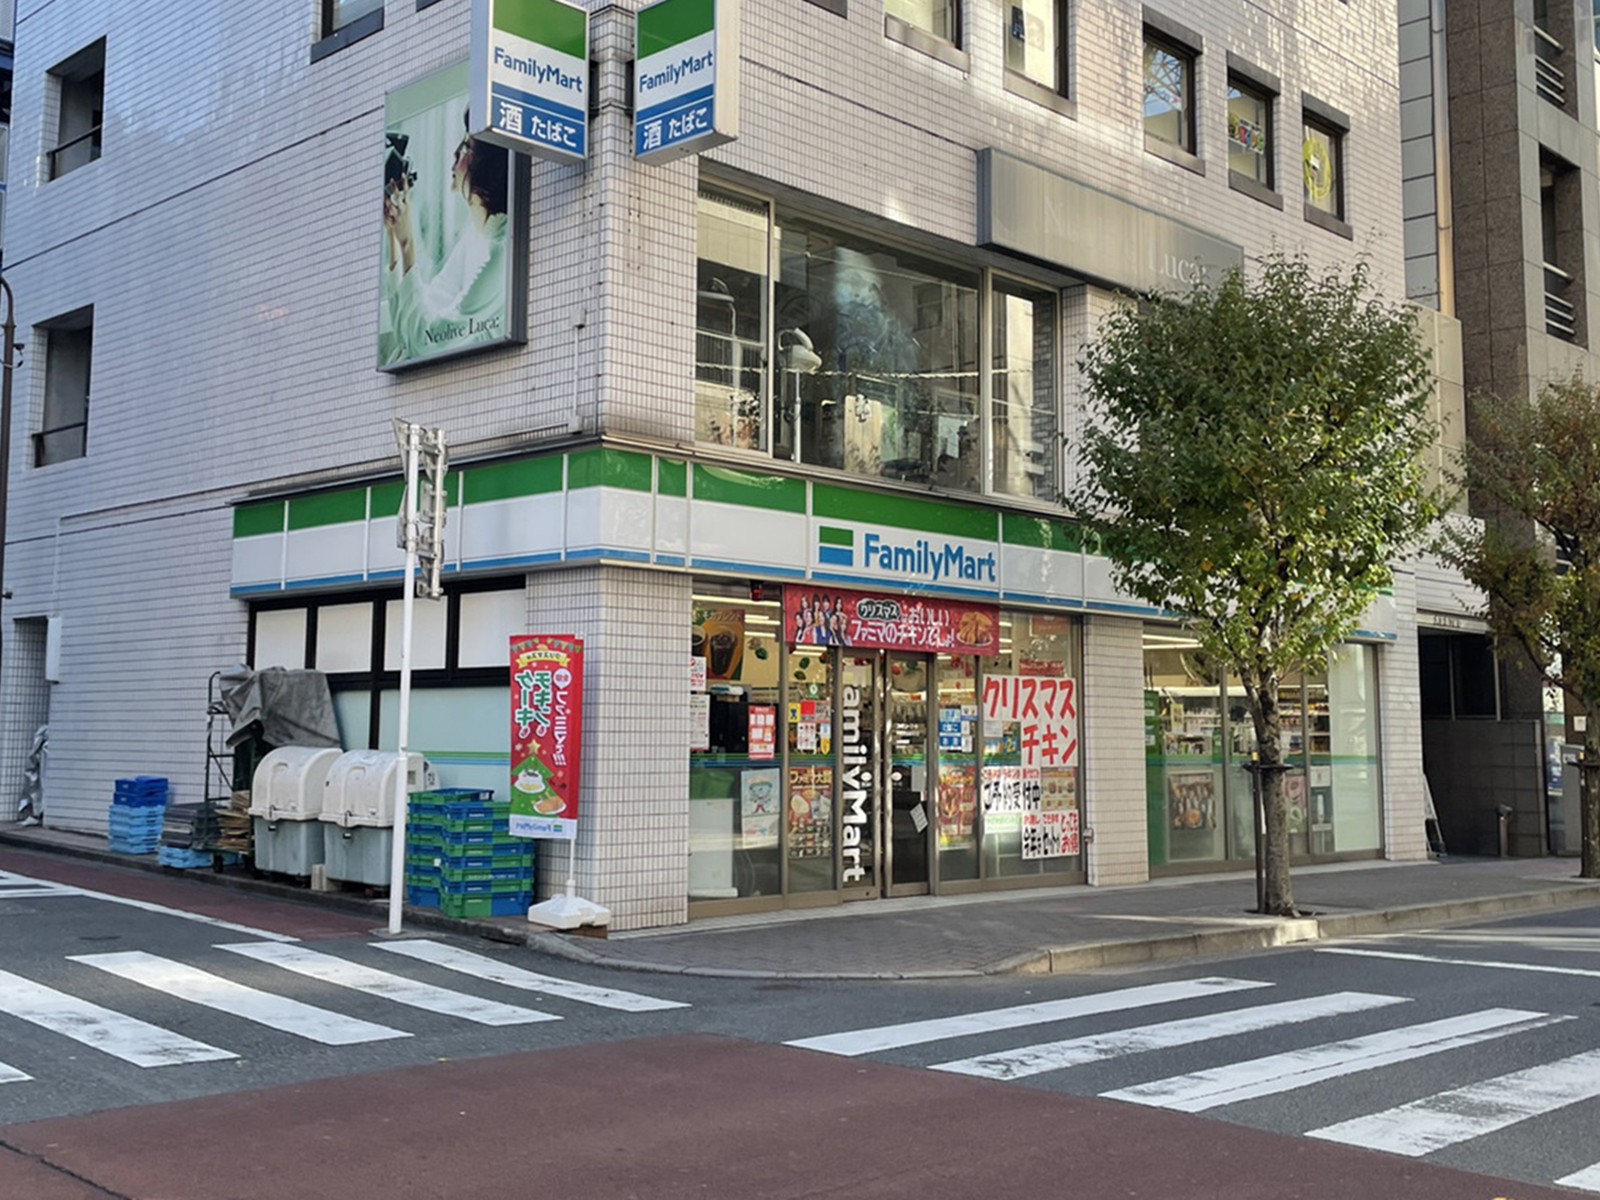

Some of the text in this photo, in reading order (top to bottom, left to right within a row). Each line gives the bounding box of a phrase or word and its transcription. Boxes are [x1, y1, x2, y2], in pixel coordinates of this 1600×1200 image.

[494, 46, 583, 93] FamilyMart
[639, 51, 714, 93] FamilyMart
[499, 101, 577, 148] 酒 たばこ
[643, 107, 708, 150] 酒 たばこ
[864, 532, 996, 582] FamilyMart
[982, 677, 1076, 720] クリスマス
[1021, 723, 1078, 765] チキン
